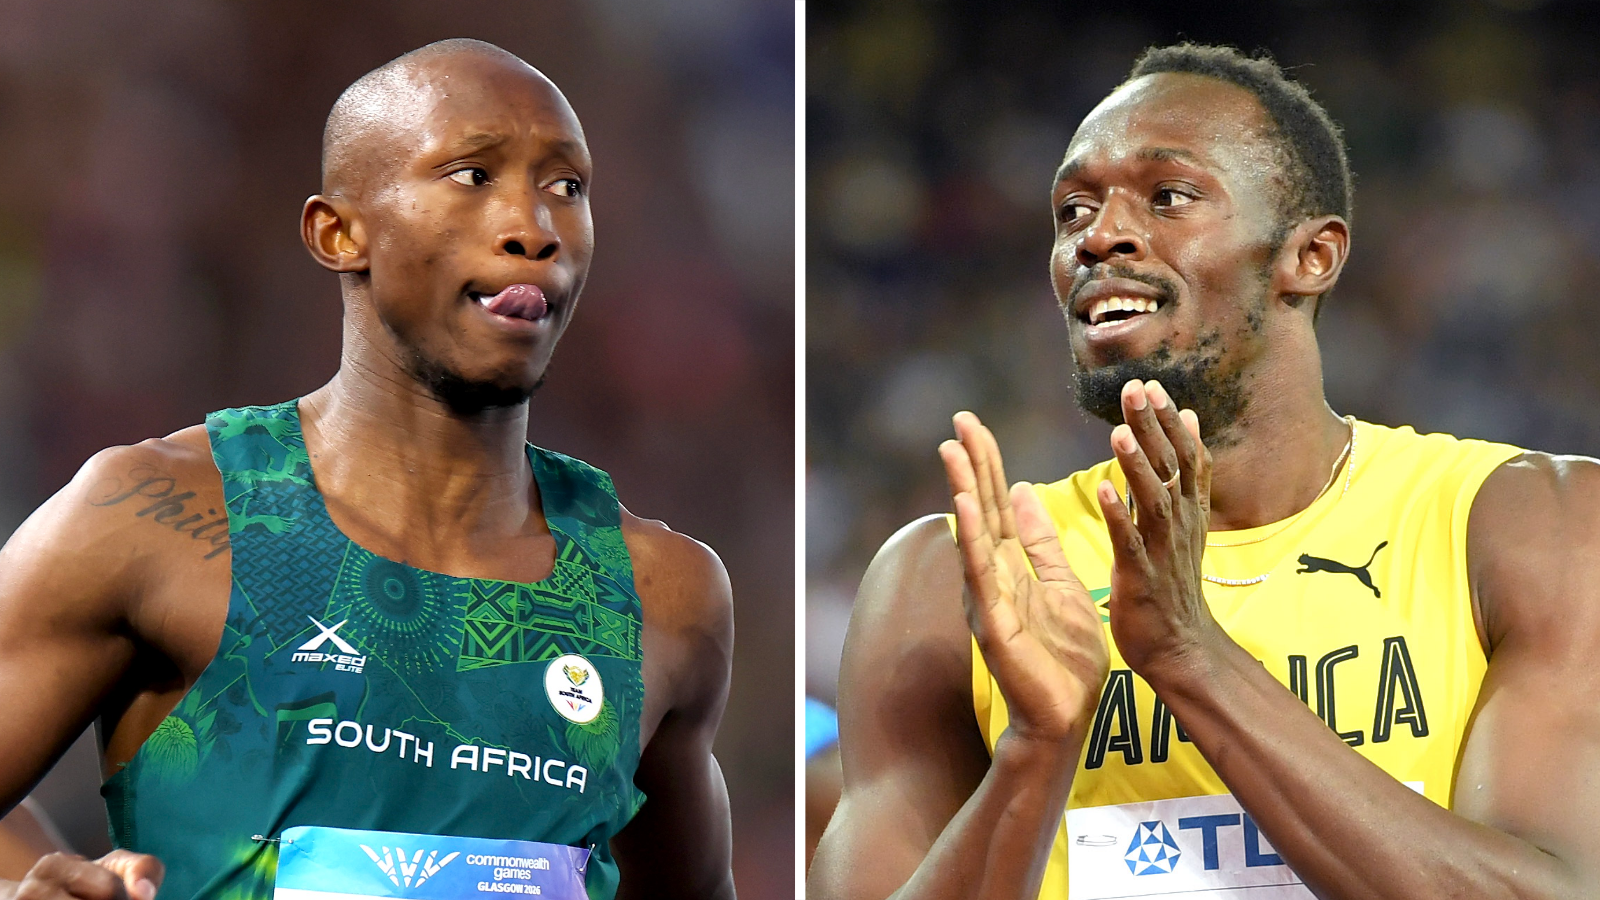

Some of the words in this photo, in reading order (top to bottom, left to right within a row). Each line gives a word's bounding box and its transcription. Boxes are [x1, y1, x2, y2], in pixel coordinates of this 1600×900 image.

[86, 465, 232, 560] Phil
[334, 663, 363, 674] ELITE
[306, 718, 434, 768] SOUTH
[450, 744, 588, 794] AFRICA
[466, 854, 550, 871] commonwealth
[493, 867, 532, 881] games
[477, 881, 523, 894] GLASGOW
[523, 884, 541, 895] 2026
